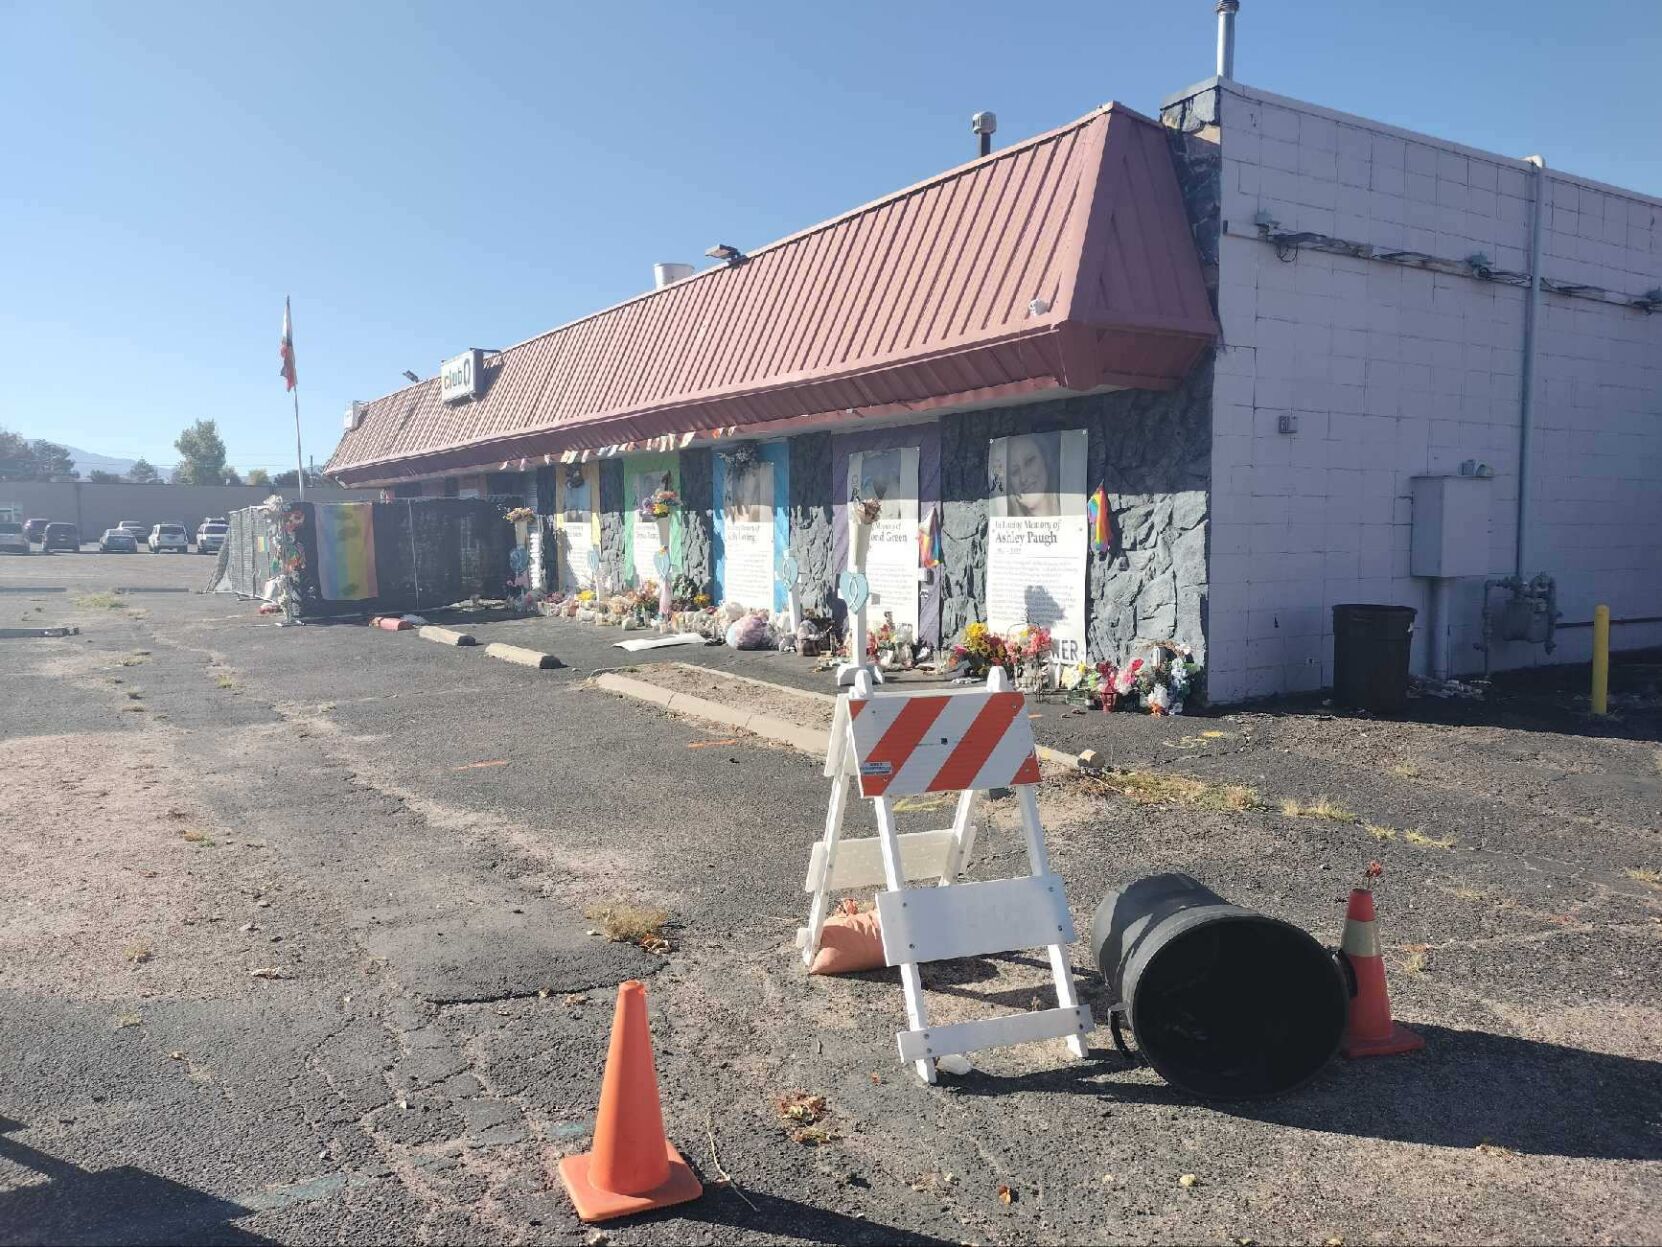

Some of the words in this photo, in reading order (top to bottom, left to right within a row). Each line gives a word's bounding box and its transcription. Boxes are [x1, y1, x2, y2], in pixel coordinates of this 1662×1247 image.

[444, 367, 462, 390] club
[1024, 520, 1051, 531] Memory
[1053, 519, 1063, 531] of
[886, 531, 908, 542] Green
[996, 531, 1025, 546] Ashley
[1027, 531, 1058, 547] Paugh
[1050, 639, 1079, 661] WER
